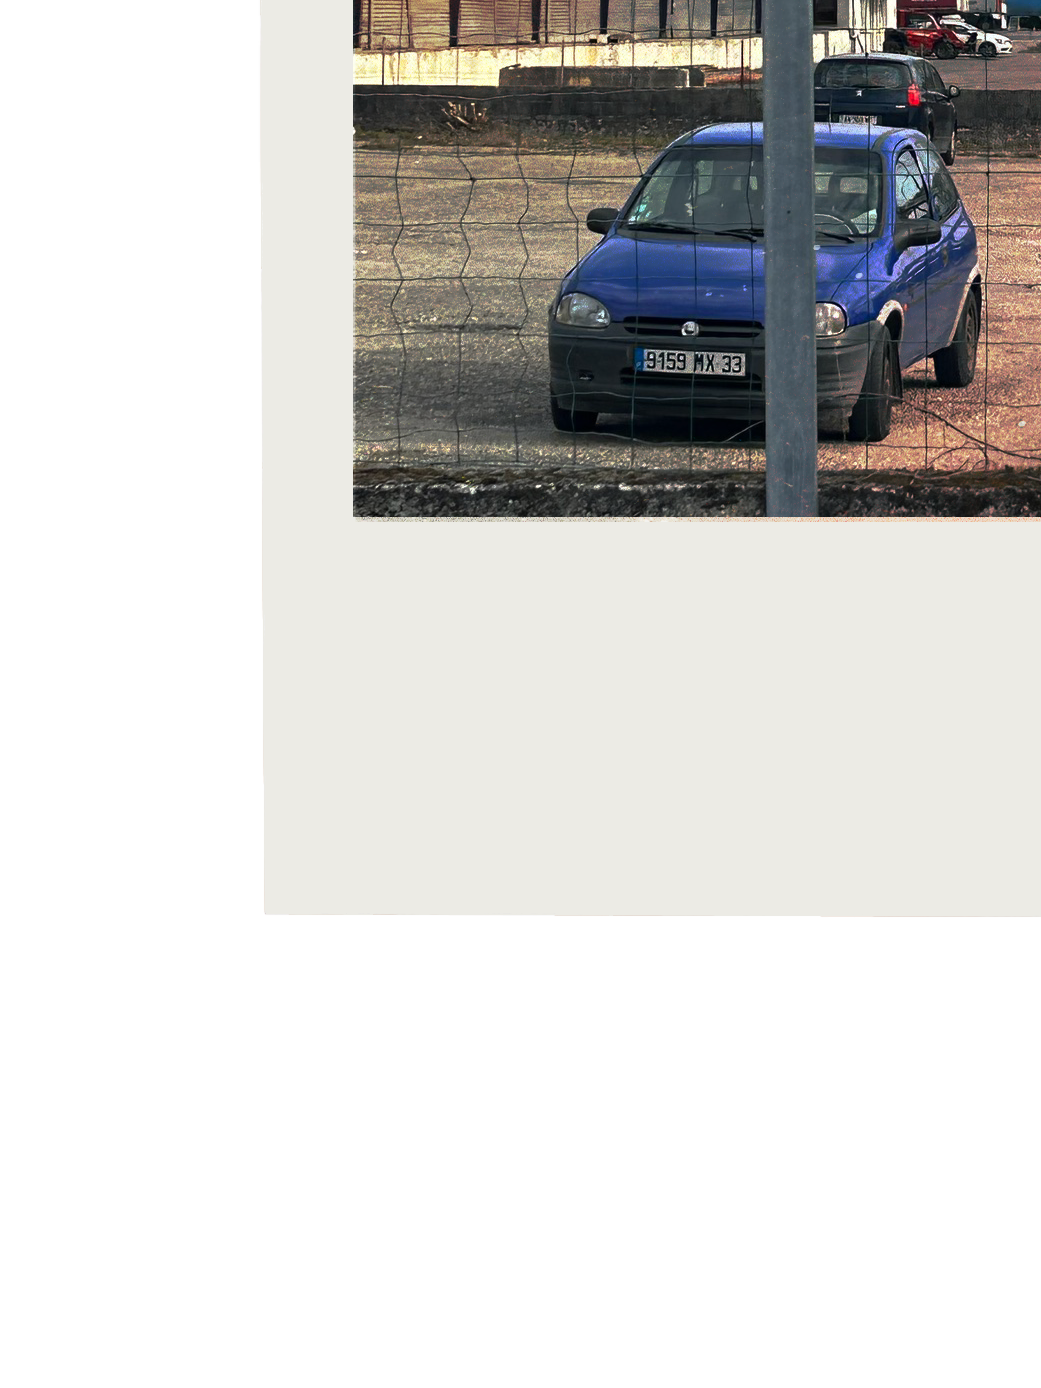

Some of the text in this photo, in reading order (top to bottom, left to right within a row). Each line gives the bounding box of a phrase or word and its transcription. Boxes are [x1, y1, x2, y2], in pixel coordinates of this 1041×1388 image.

[646, 351, 742, 373] 9159 MX 33
